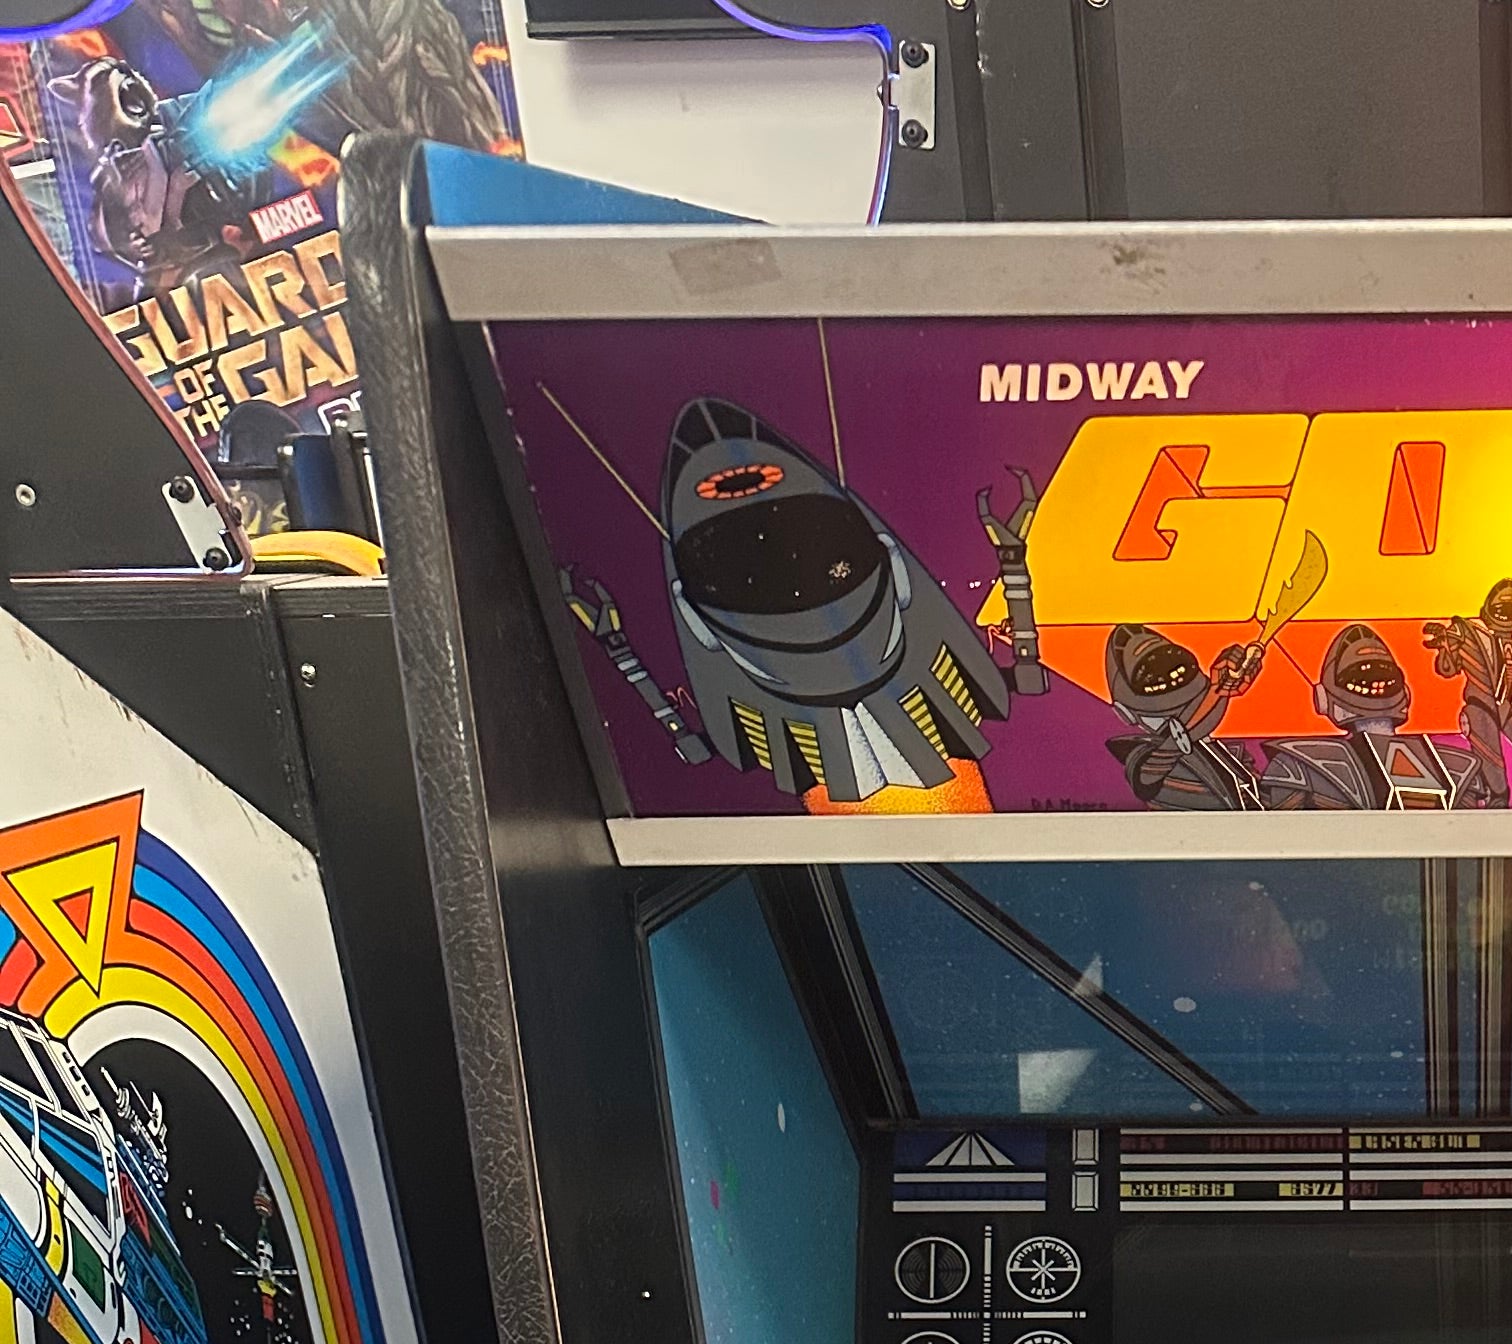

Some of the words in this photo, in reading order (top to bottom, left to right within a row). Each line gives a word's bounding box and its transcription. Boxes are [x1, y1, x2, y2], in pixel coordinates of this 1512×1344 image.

[251, 190, 322, 243] MARVEL
[174, 359, 216, 403] OF
[979, 360, 1205, 403] MIDWAY
